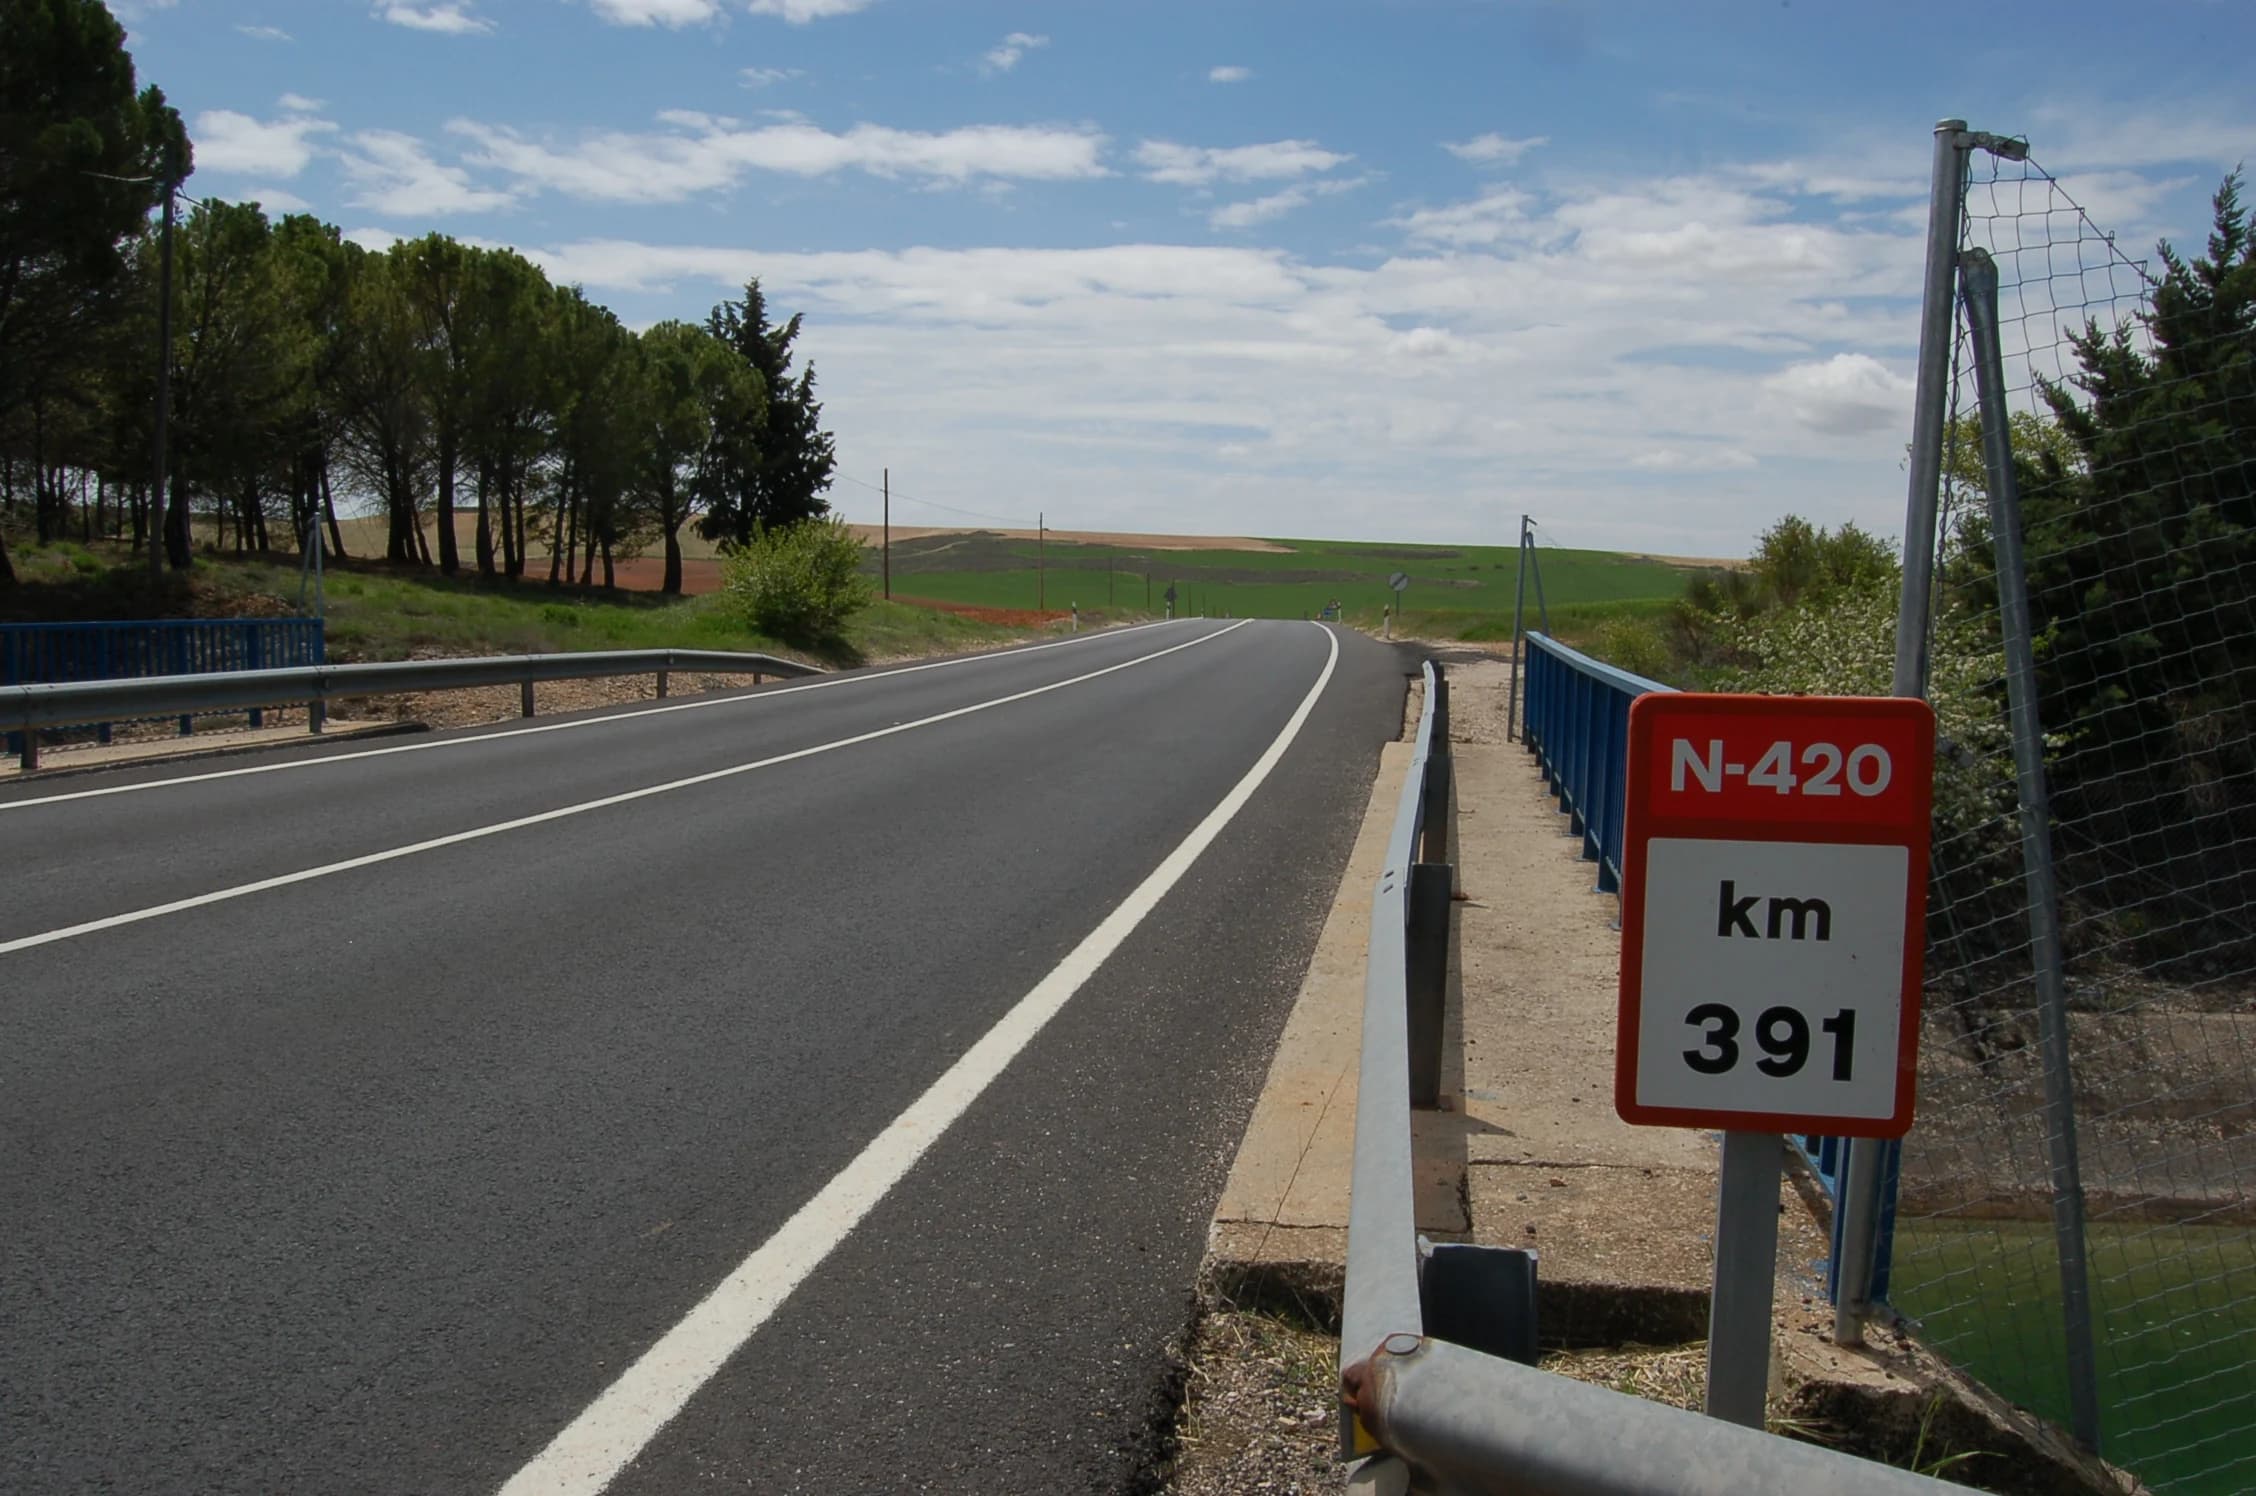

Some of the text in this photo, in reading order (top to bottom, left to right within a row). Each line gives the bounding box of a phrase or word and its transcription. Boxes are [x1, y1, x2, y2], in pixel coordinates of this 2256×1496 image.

[1671, 738, 1892, 797] N-420
[1717, 880, 1832, 941] km
[1682, 1003, 1856, 1082] 391
